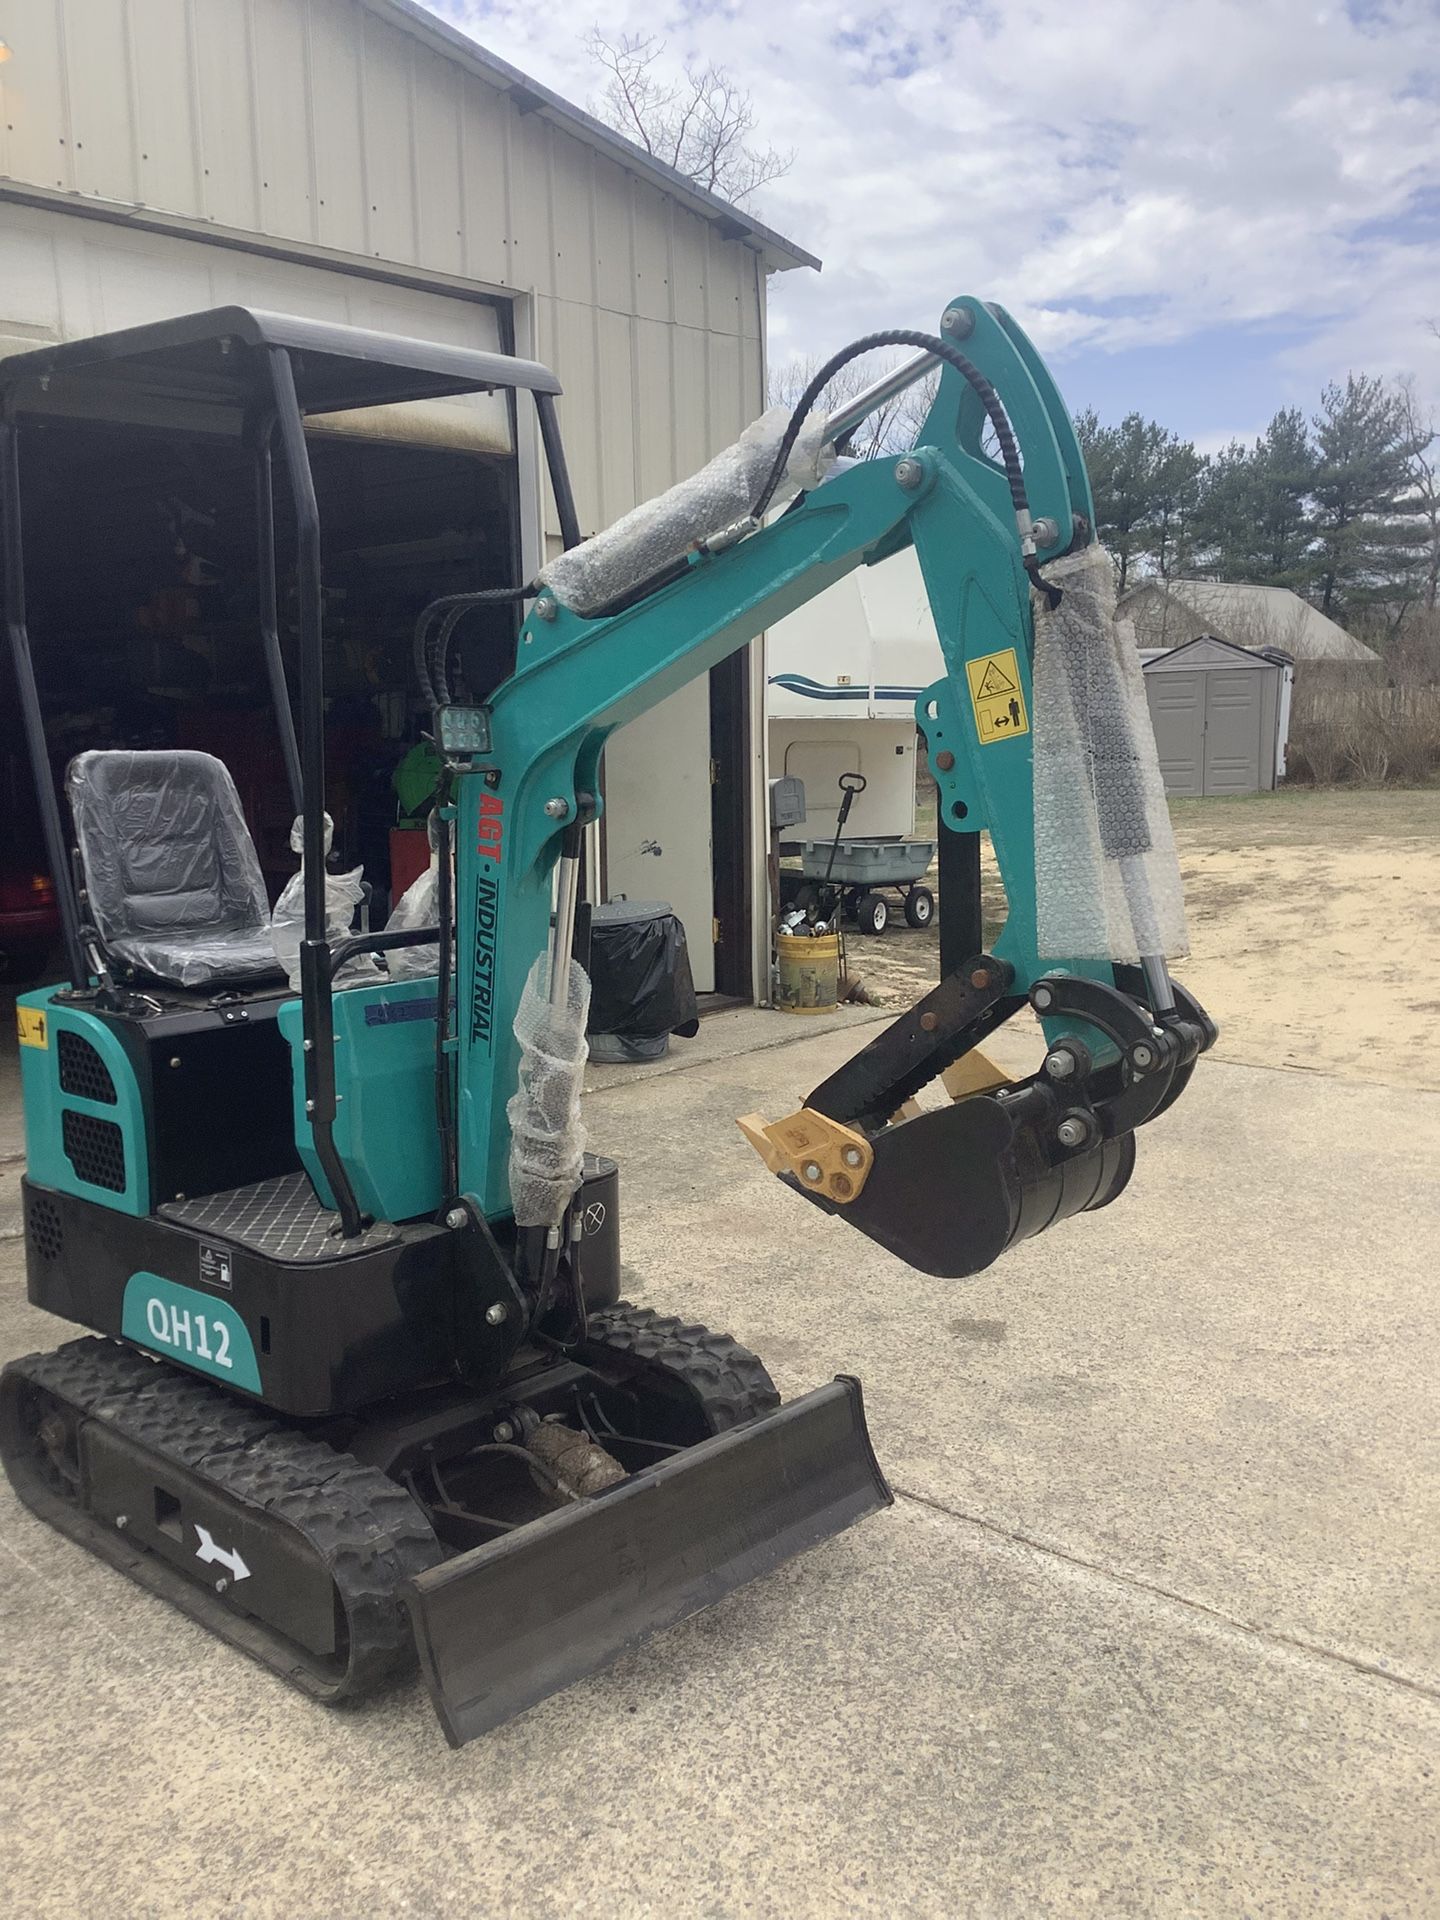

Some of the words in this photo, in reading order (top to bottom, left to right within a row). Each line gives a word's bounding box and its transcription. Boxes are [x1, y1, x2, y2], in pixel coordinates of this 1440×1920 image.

[476, 793, 504, 864] AGT
[472, 878, 497, 1045] INDUSTRIAL
[146, 1298, 233, 1369] QH12
